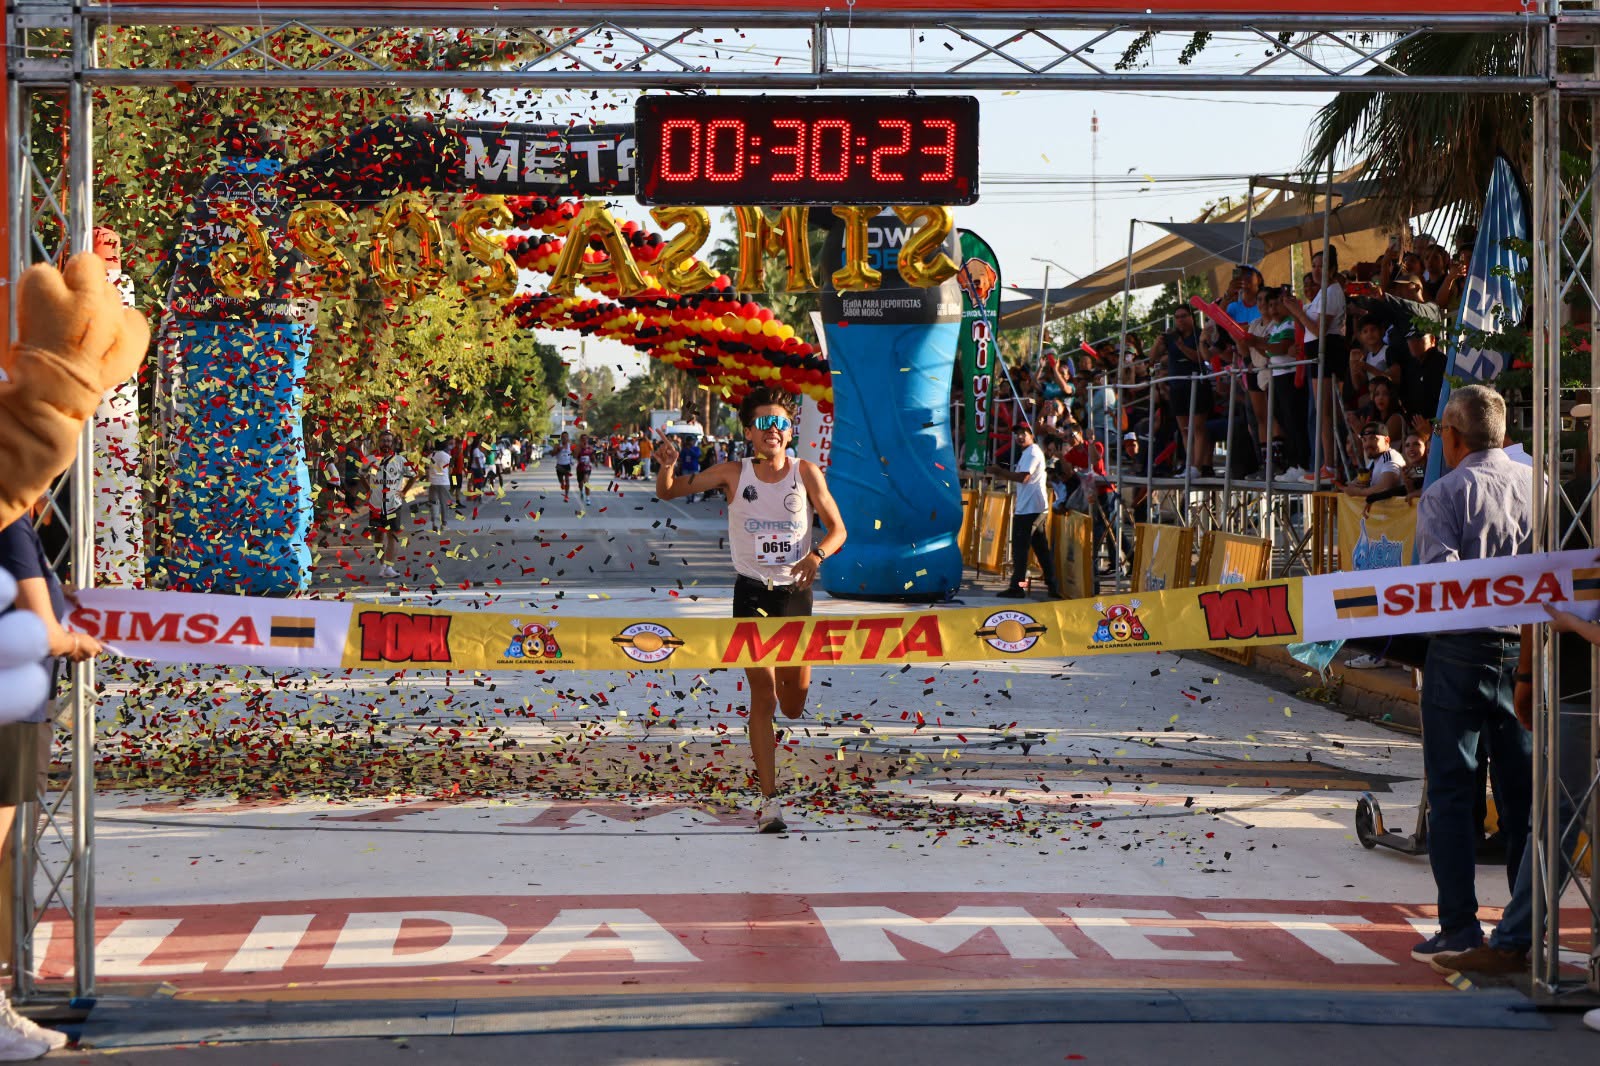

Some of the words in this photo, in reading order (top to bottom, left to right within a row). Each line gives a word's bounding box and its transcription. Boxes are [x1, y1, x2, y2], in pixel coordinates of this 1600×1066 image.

[661, 119, 956, 182] 00:30:23
[863, 299, 879, 308] PARA
[881, 299, 922, 308] DEPORTISTAS
[861, 308, 883, 316] MORAS
[763, 541, 791, 553] 0615
[1383, 572, 1569, 617] SIMSA
[991, 613, 1026, 624] GRUPO
[69, 607, 264, 646] SIMSA
[629, 625, 664, 635] GRUPO
[721, 614, 944, 664] META
[995, 639, 1032, 650] SIMSA
[631, 648, 668, 660] SIMSA
[33, 907, 704, 977] LIDA
